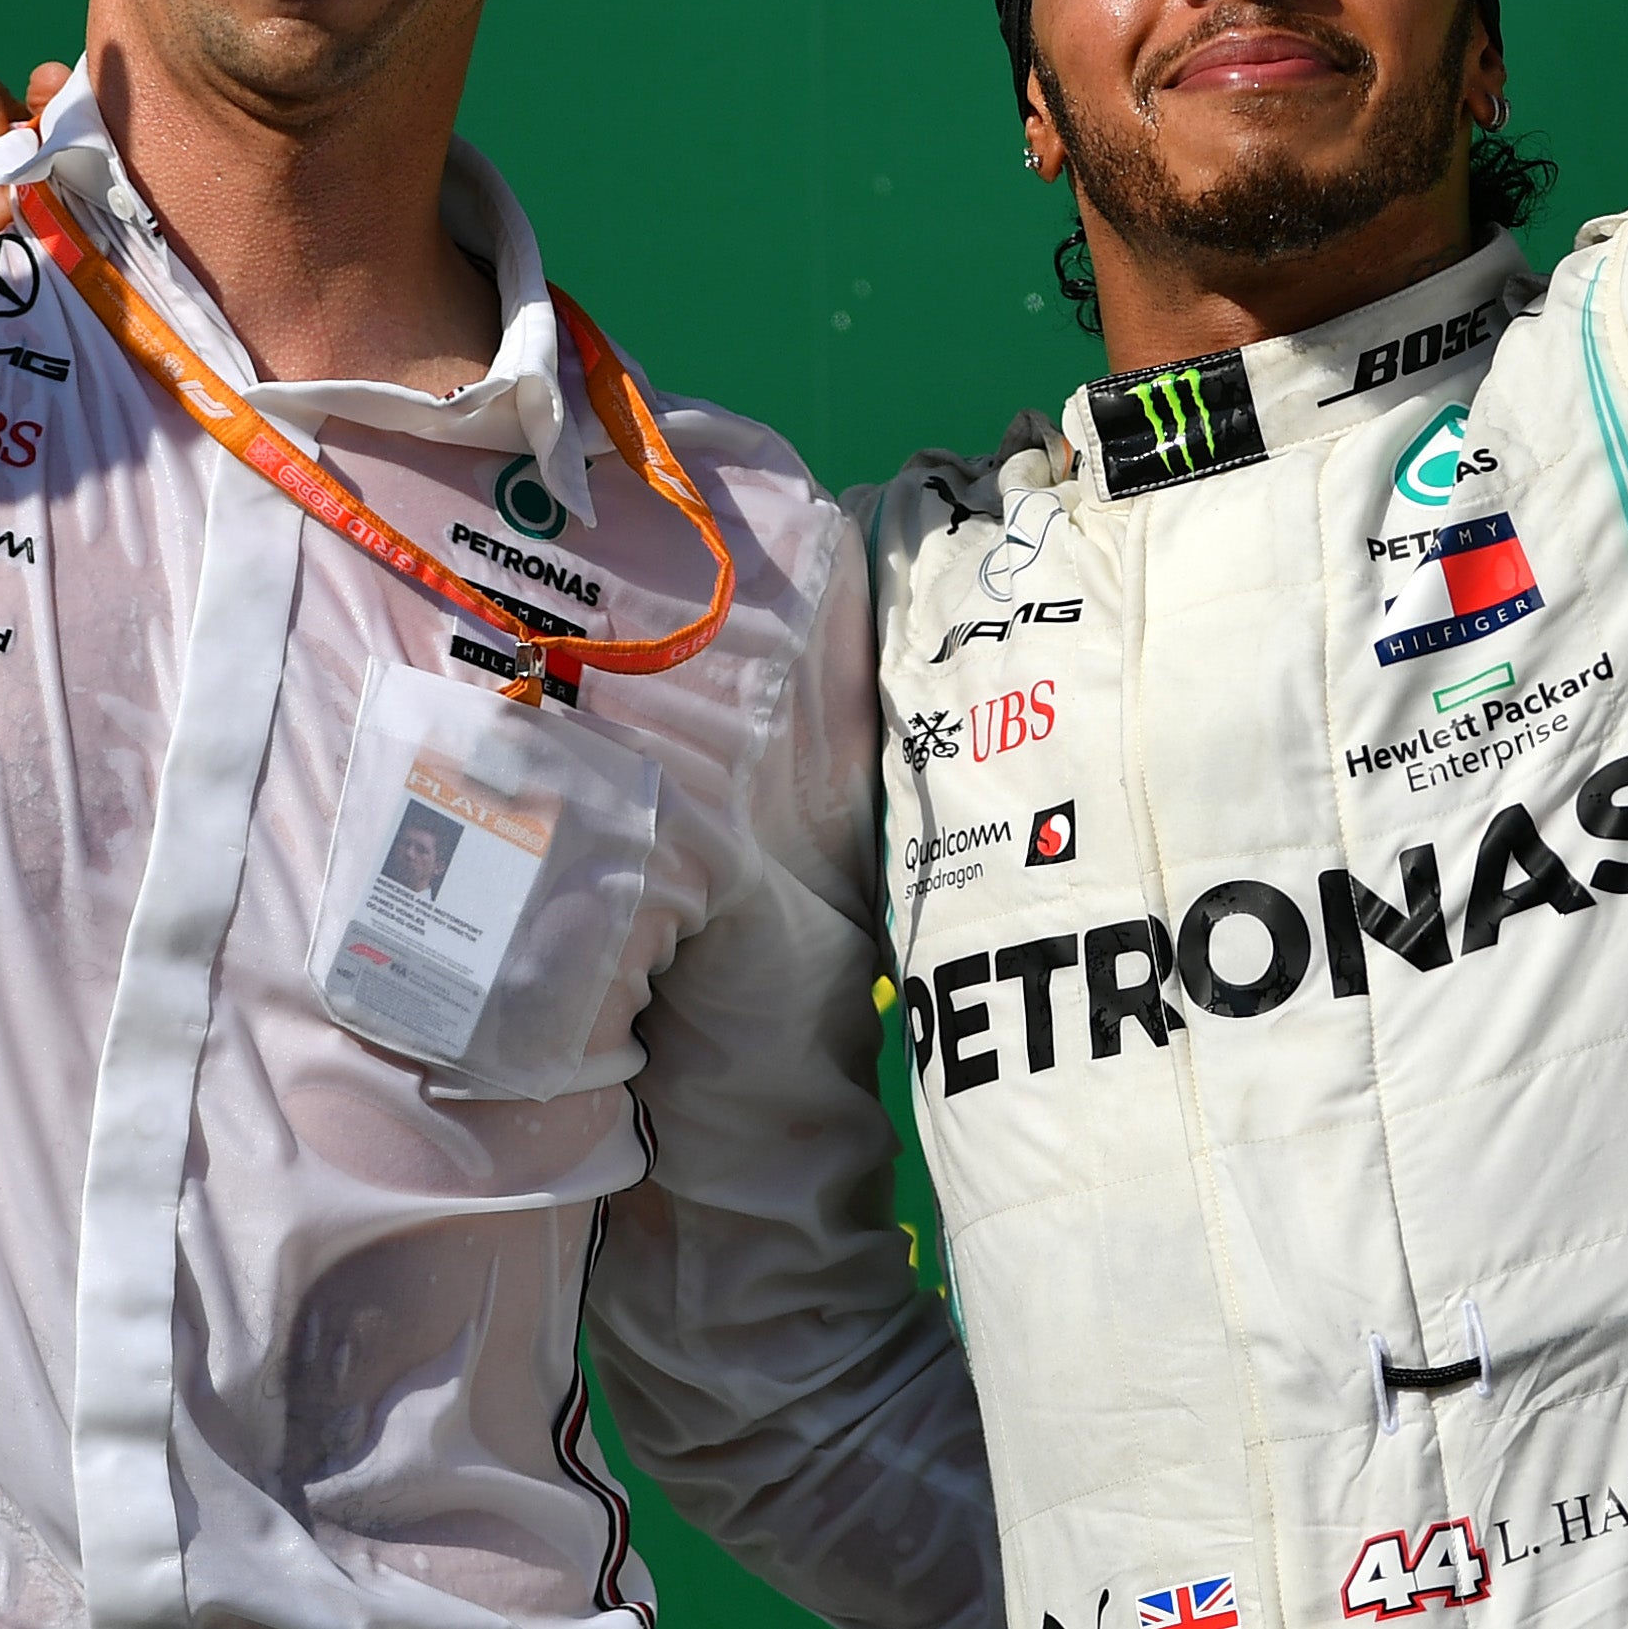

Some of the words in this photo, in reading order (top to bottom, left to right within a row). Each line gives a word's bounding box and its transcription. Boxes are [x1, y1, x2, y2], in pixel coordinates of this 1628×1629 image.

[1319, 298, 1497, 408] BOSE
[347, 518, 417, 573] GRID
[452, 523, 601, 607] PETRONAS
[1428, 521, 1498, 556] MMY
[475, 588, 576, 636] OMMY
[960, 598, 1084, 647] AMG
[1388, 598, 1530, 657] HILFIGER
[463, 645, 566, 697] HILFER
[969, 679, 1056, 763] UBS
[1345, 713, 1481, 778] Hewlett
[1482, 651, 1615, 732] Packard
[1405, 713, 1570, 793] Enterprise
[904, 820, 1012, 873] Qualcomm
[904, 861, 984, 900] snapdragon
[1340, 1516, 1492, 1623] 44
[1494, 1518, 1542, 1567] L.
